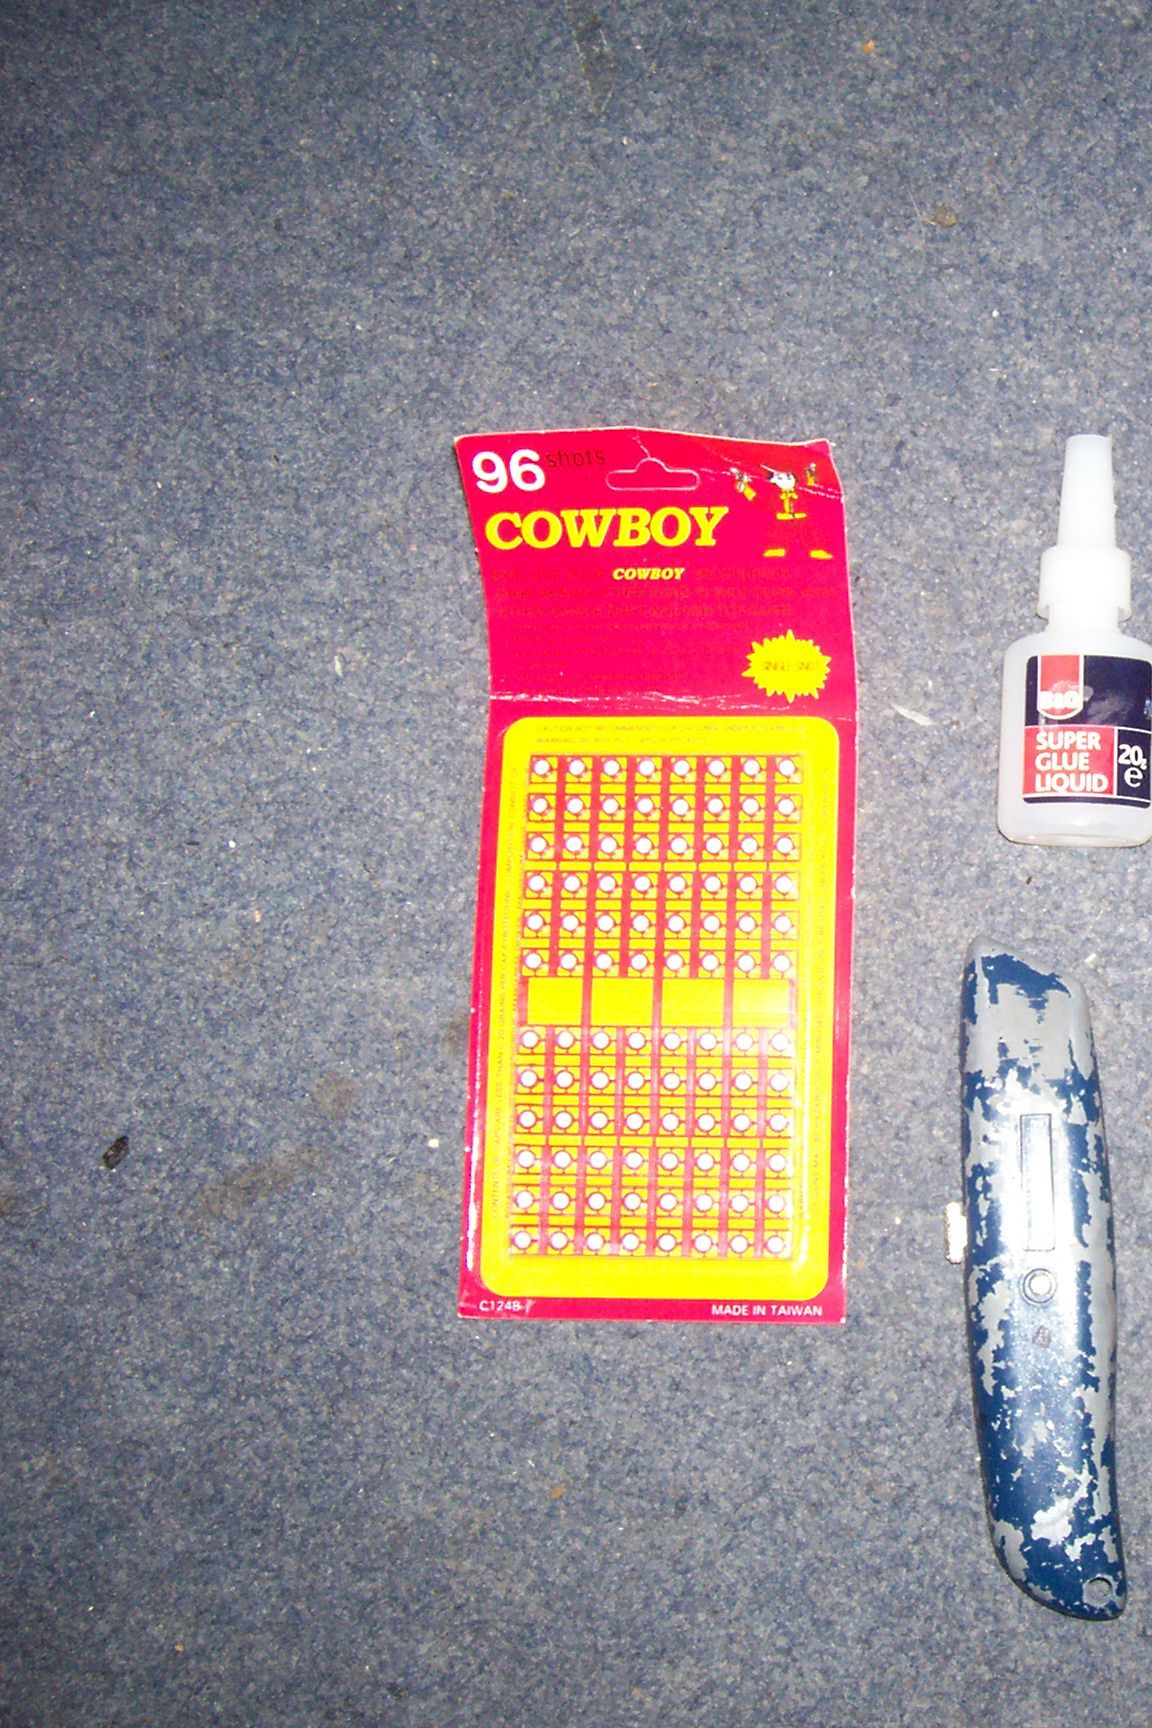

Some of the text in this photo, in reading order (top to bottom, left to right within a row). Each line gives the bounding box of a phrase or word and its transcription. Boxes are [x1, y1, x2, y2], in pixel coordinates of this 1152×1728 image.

[472, 449, 606, 493] 96 shots
[485, 506, 729, 550] COWBOY
[612, 567, 685, 580] COWBOY
[1035, 731, 1102, 751] SUPER
[1035, 752, 1090, 771] GLUE
[1035, 773, 1109, 794] LIQUID
[711, 1304, 823, 1316] MADE IN TAIWAN
